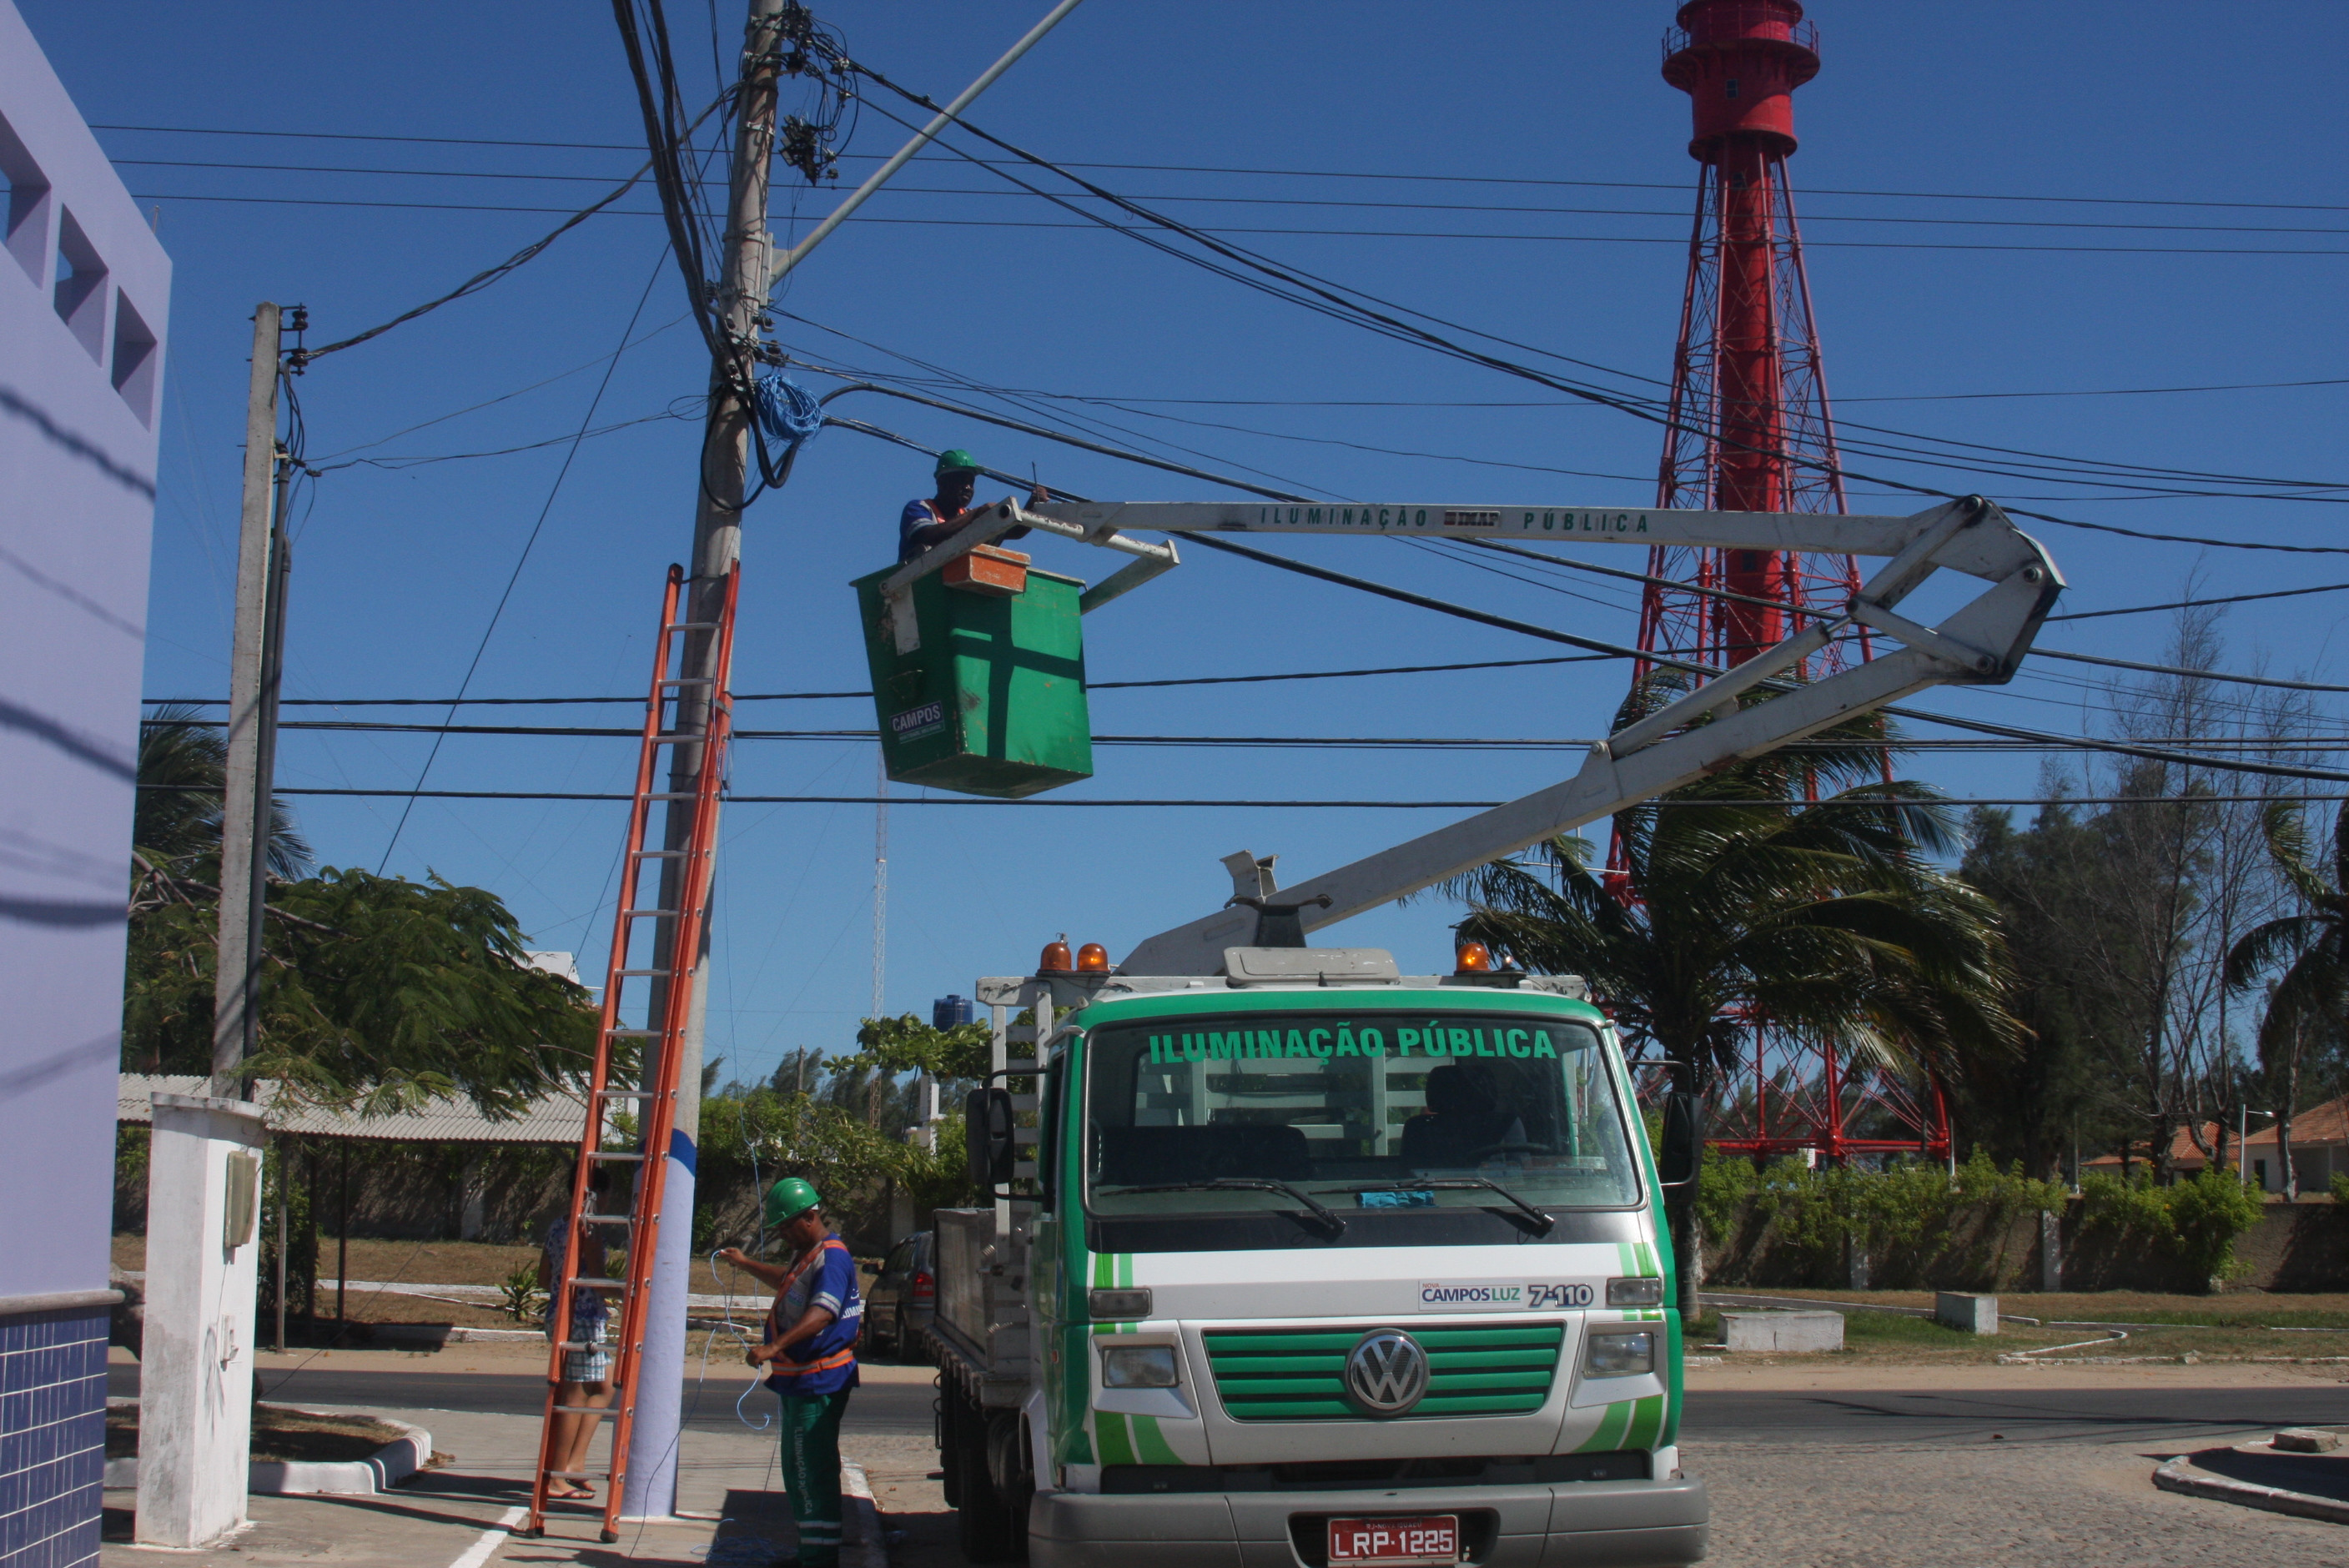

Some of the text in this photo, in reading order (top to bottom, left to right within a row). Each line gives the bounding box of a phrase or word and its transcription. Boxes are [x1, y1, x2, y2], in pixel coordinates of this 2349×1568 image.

[1260, 505, 1427, 530] ILUMINAÇÃO
[1523, 508, 1647, 533] PÚBLICA
[892, 705, 941, 731] CAMPOS
[1149, 1020, 1558, 1066] ILUMINAÇÃO PÚBLICA
